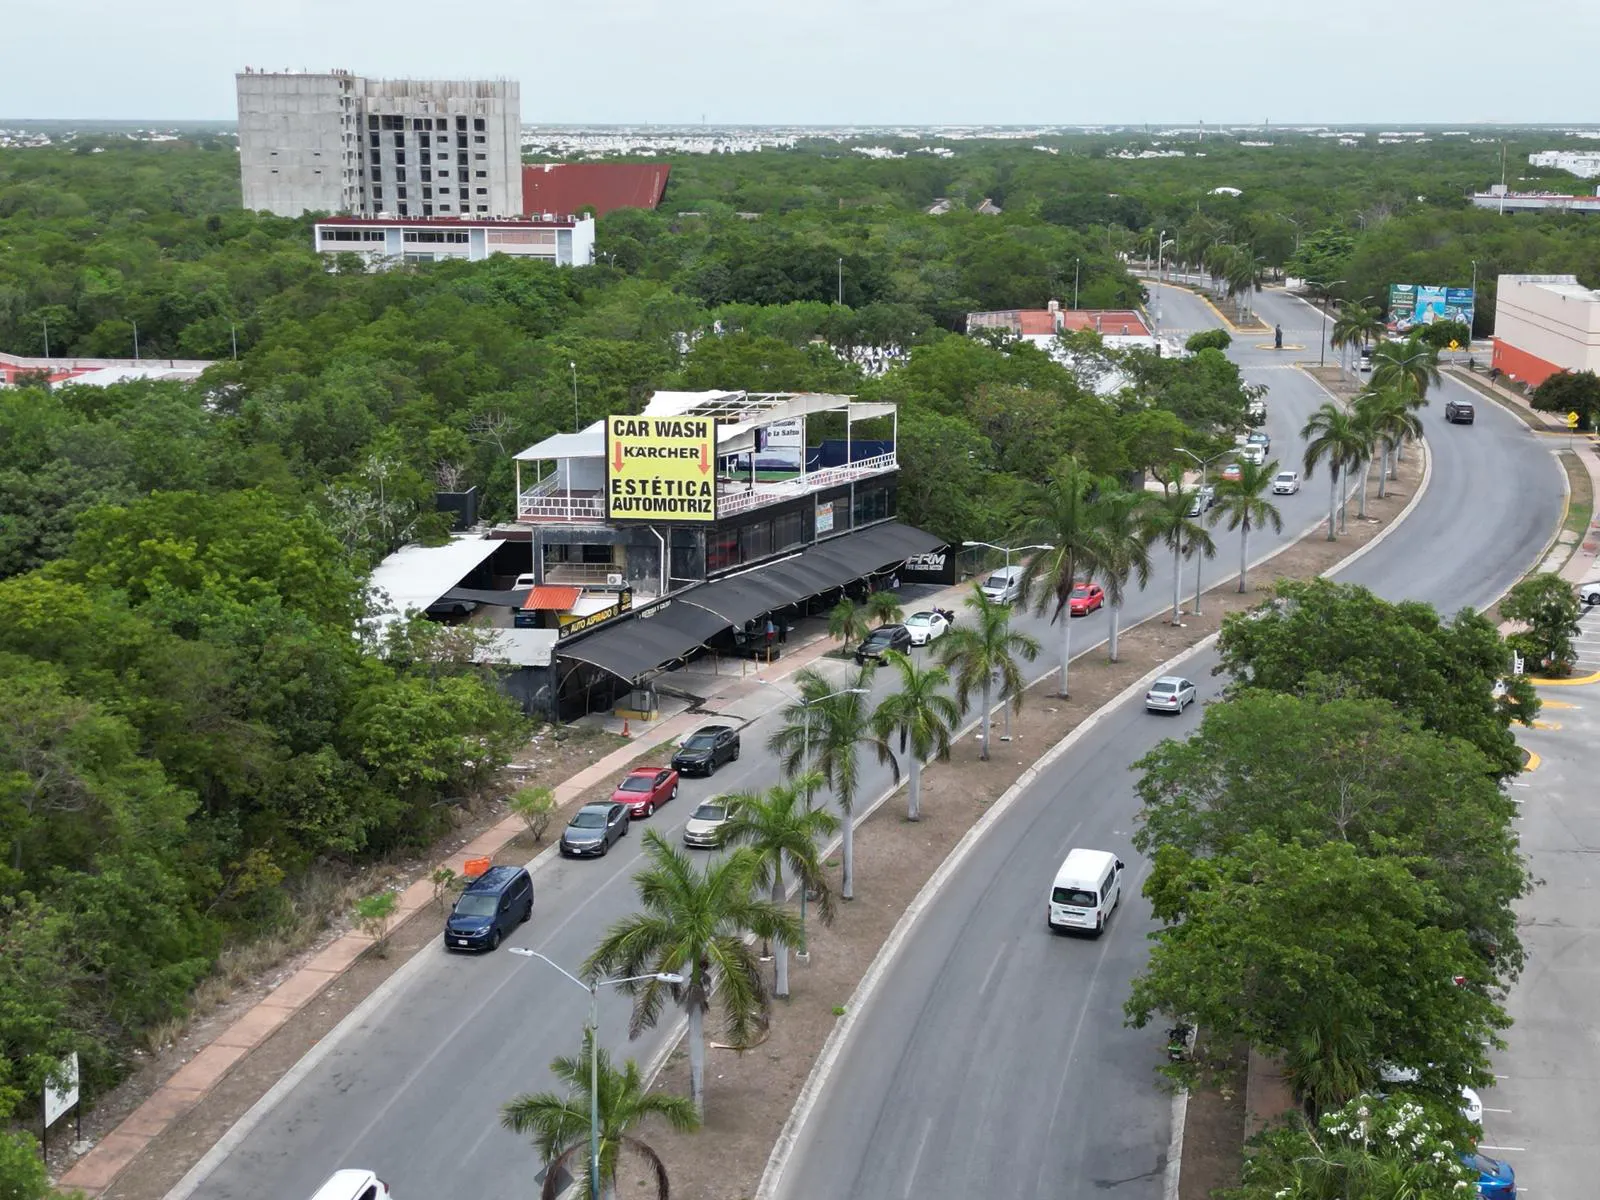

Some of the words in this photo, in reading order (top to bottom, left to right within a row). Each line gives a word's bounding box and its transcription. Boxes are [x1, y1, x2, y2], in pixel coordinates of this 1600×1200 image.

[613, 419, 650, 437] CAR
[654, 420, 707, 438] WASH
[624, 446, 700, 459] KÄRCHER
[611, 476, 712, 497] ESTÉTICA
[612, 496, 712, 513] AUTOMOTRIZ
[570, 619, 586, 634] AUTO
